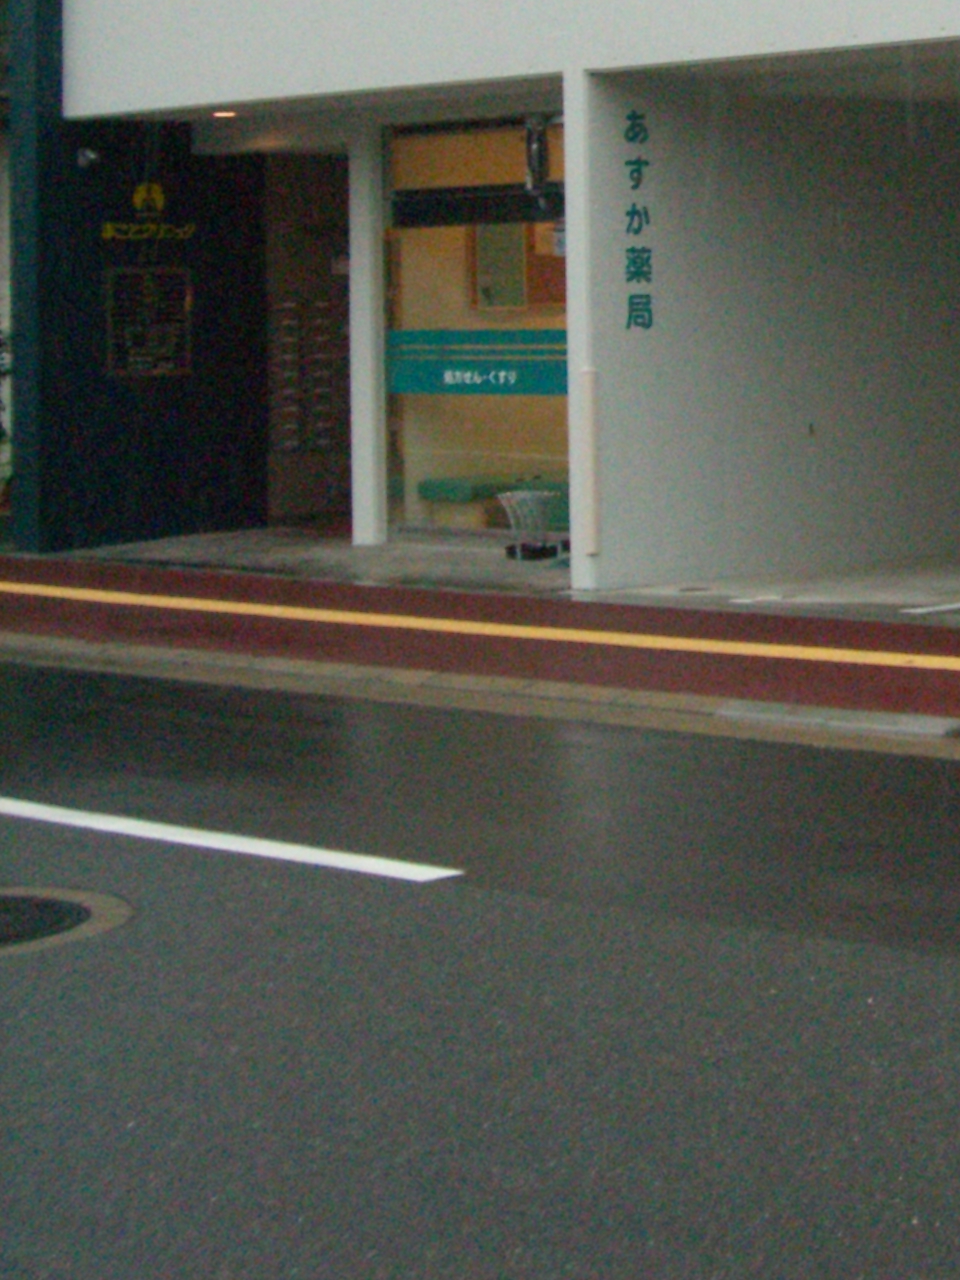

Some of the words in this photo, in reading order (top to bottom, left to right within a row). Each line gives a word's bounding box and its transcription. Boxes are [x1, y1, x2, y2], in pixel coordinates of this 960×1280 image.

[624, 109, 654, 331] あすか薬局
